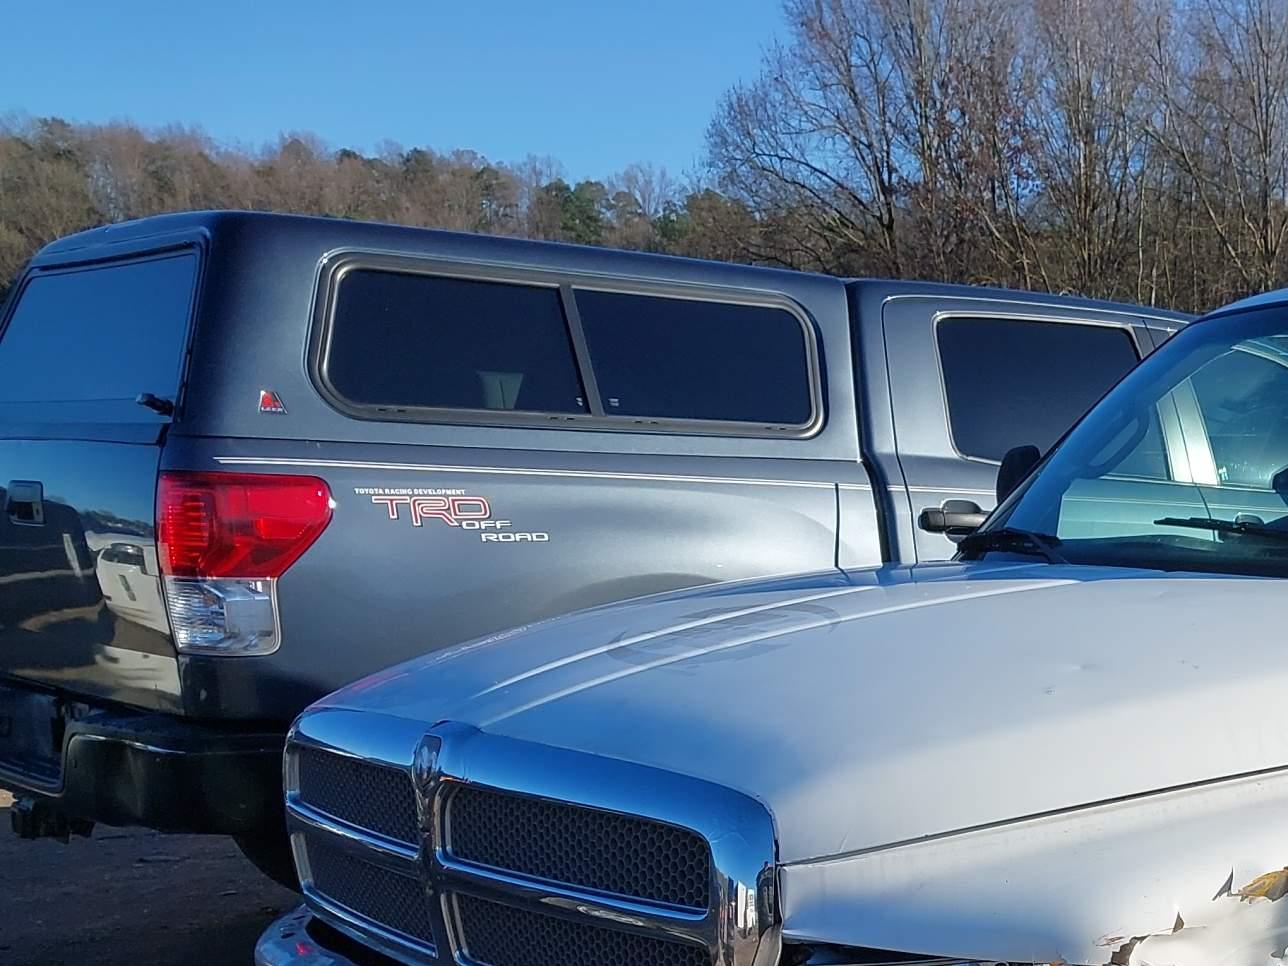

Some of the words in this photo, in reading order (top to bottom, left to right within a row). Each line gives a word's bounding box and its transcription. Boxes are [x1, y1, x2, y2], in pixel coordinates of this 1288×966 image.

[354, 487, 384, 495] TOYOTA
[413, 488, 466, 496] DEVELOPMENT
[371, 495, 491, 527] TRD
[461, 520, 513, 530] OFF
[481, 532, 550, 542] ROAD
